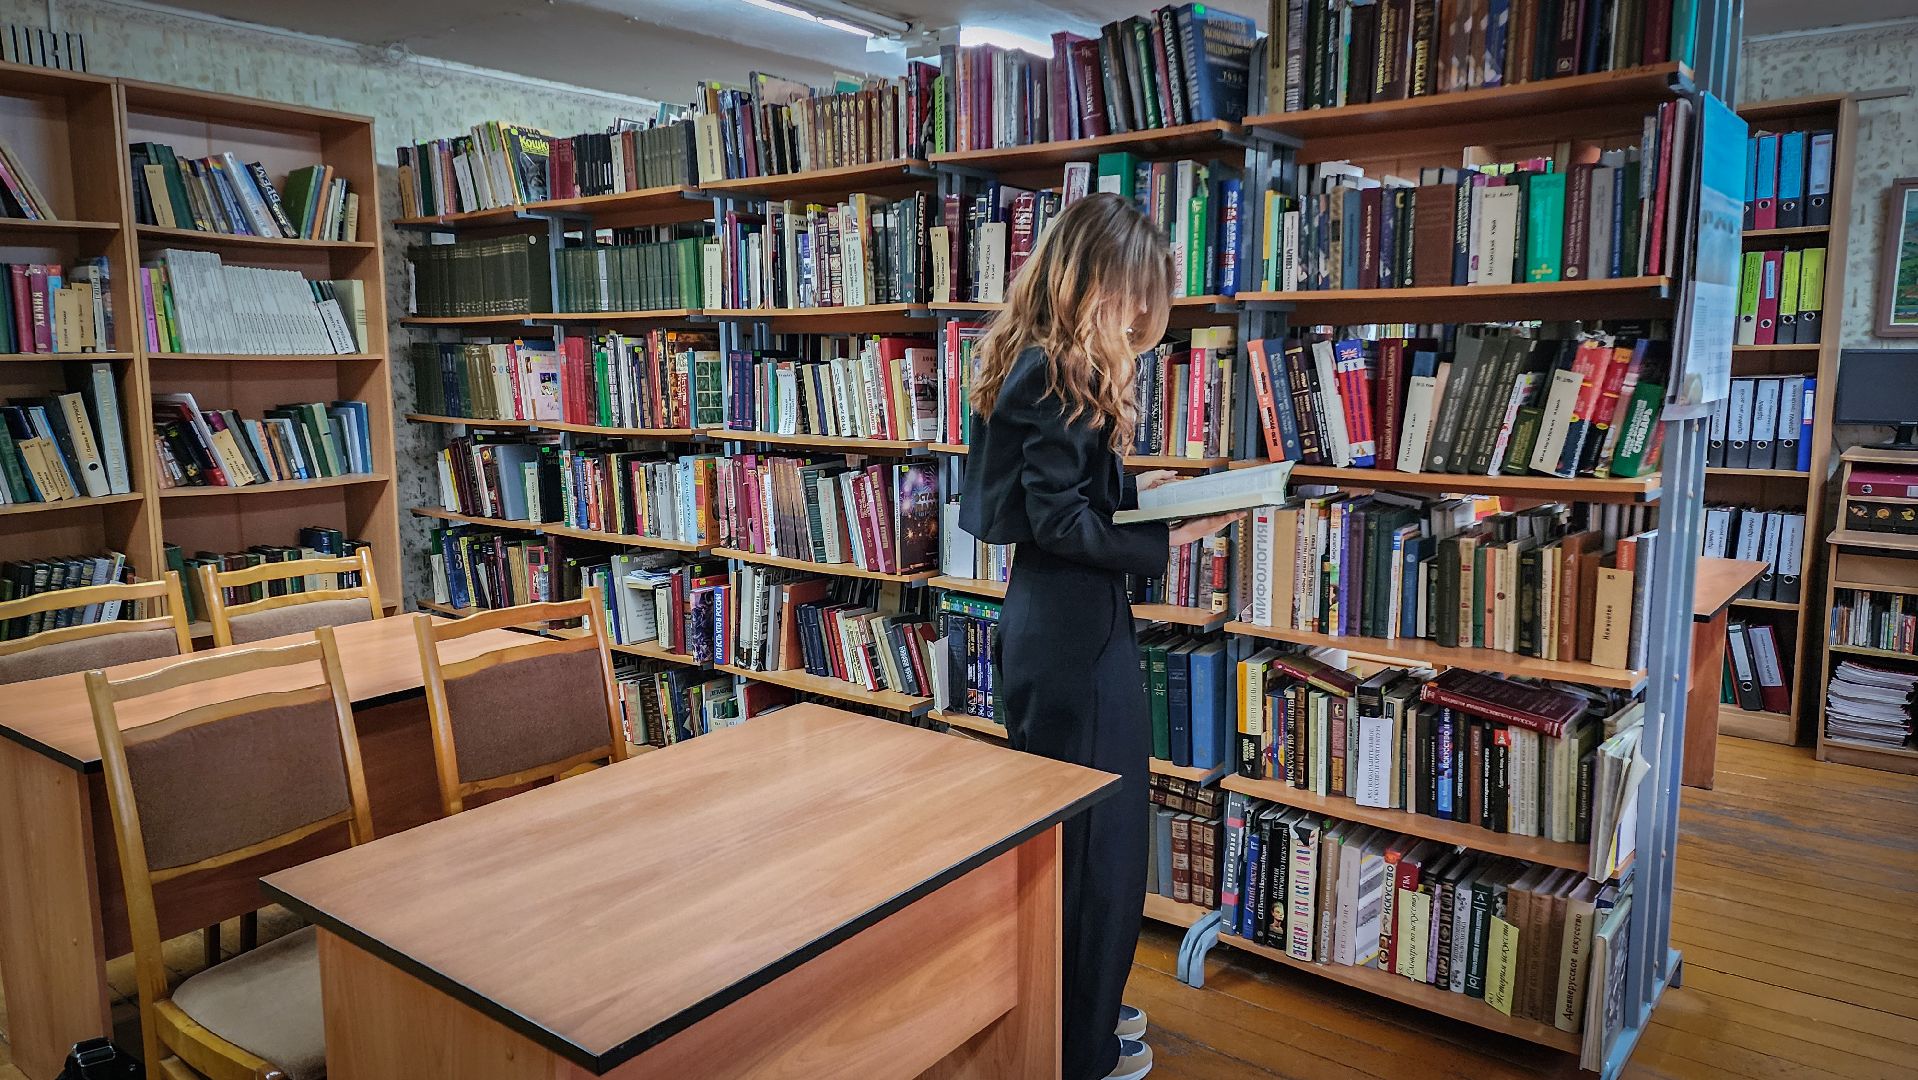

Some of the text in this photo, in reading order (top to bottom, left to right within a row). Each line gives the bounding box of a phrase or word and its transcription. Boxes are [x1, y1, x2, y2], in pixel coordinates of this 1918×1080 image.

[254, 164, 280, 204] БРЕМ
[916, 194, 924, 245] САХАРОВ
[33, 291, 44, 326] ХИМИЯ
[1255, 525, 1268, 620] МИФОЛОГИЯ
[714, 592, 726, 617] РОССИИ
[714, 633, 724, 647] ЕСТЬ
[715, 621, 724, 634] КТО
[714, 647, 724, 660] КТО
[1382, 864, 1396, 914] ИСКУССТВО
[1494, 963, 1511, 1005] История
[1562, 912, 1583, 1021] Древнерусское искусство
